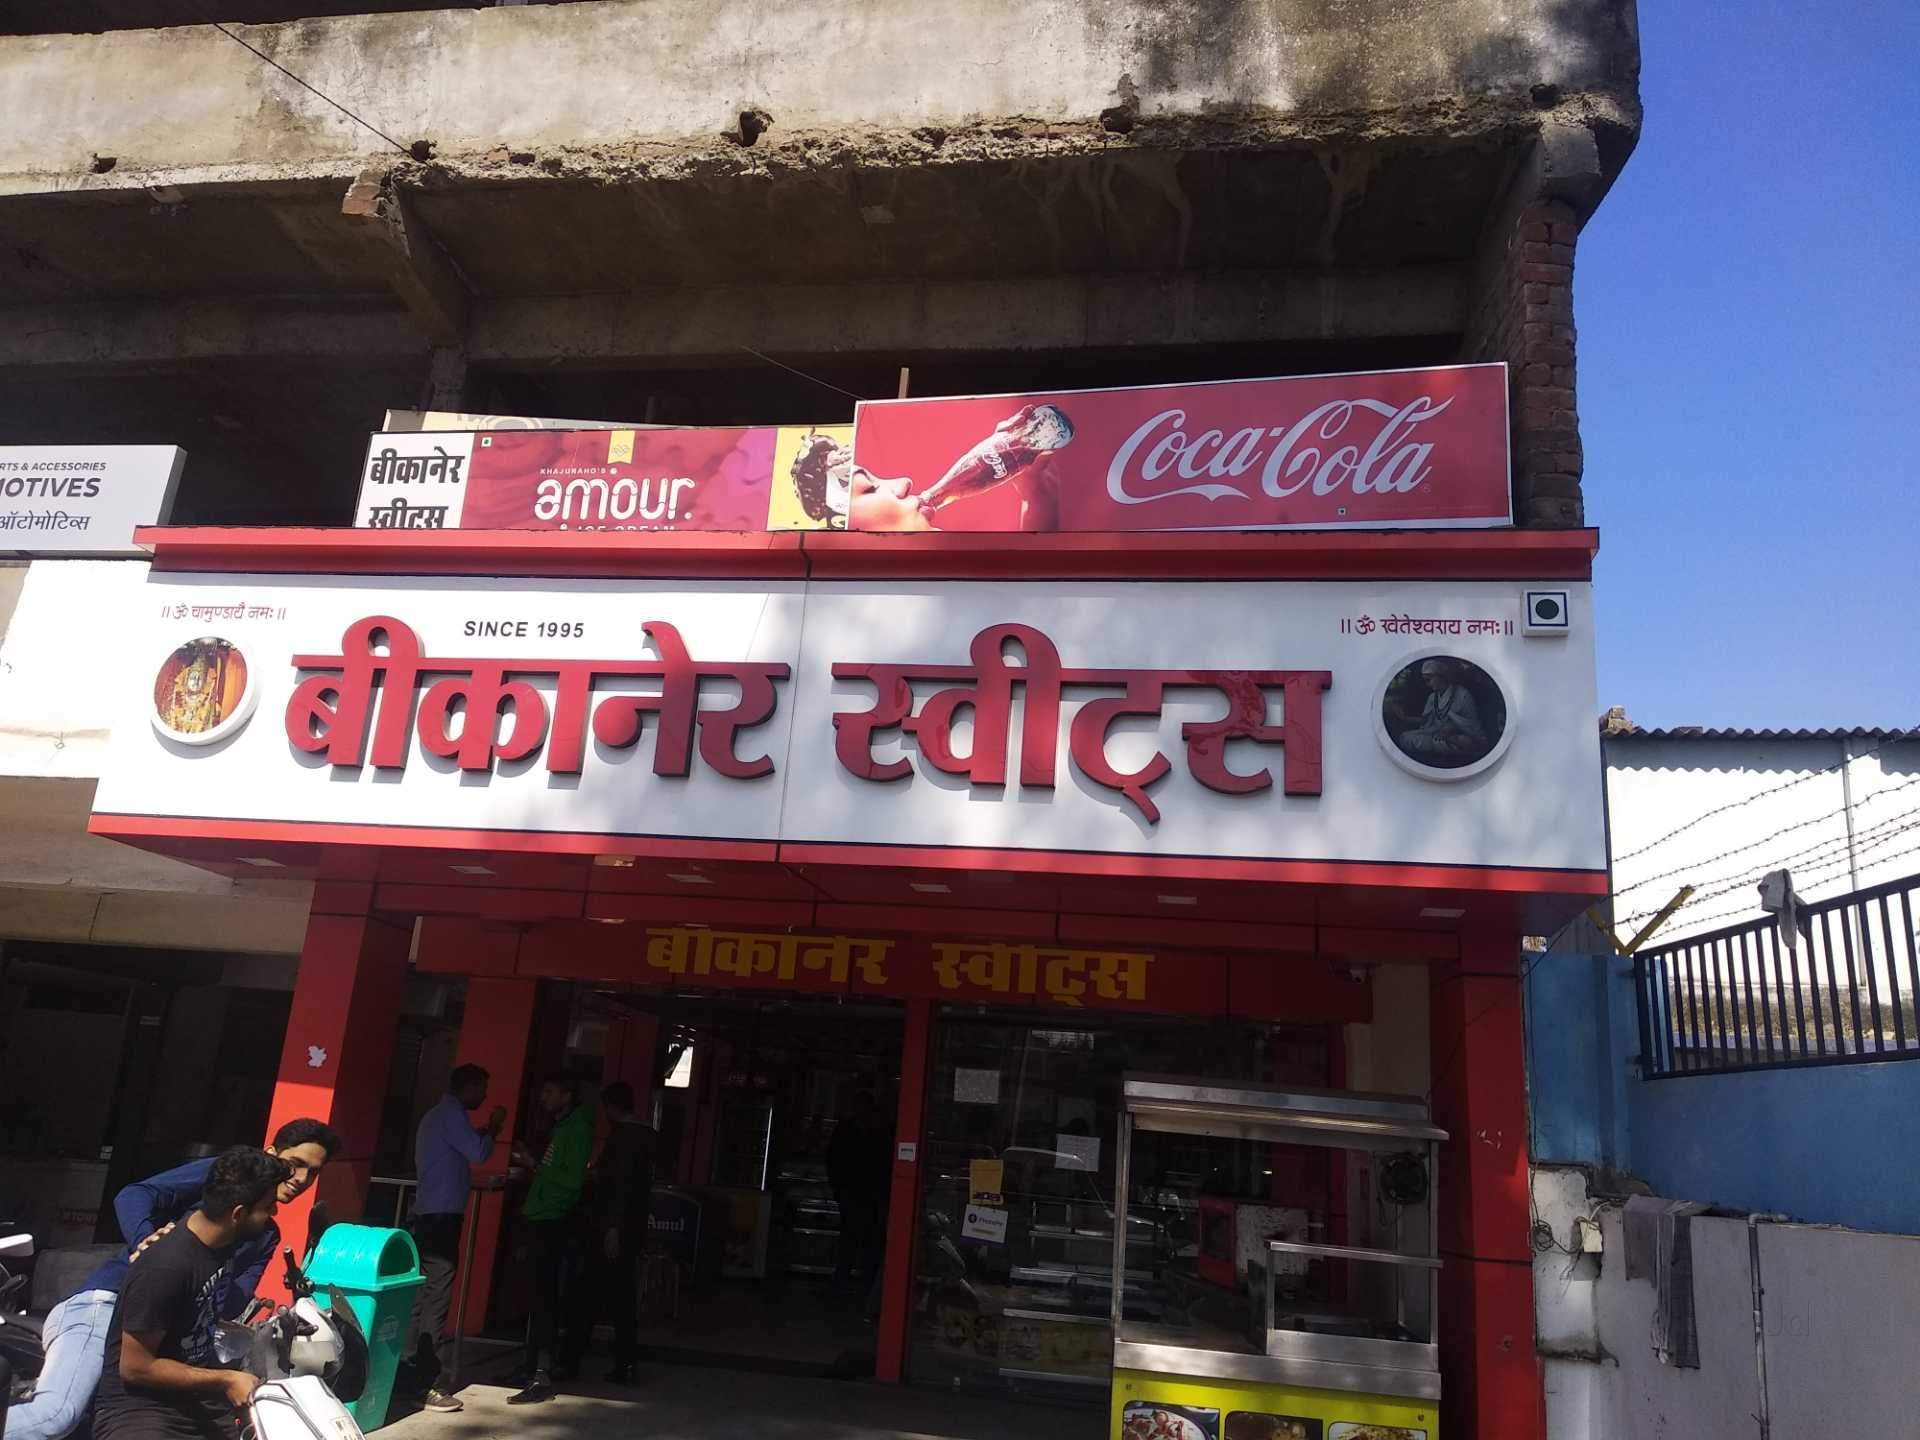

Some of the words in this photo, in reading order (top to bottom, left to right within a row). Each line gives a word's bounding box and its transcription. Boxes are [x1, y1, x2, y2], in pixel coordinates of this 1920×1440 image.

[1107, 394, 1455, 504] Coca-Cola
[21, 463, 29, 471] &
[31, 462, 107, 471] ACCESSORIES
[370, 446, 465, 484] बीकानेर
[0, 477, 101, 497] OTIVES
[464, 620, 528, 637] SINCE
[536, 622, 585, 638] 1995
[285, 615, 791, 779] बीकानेर
[831, 622, 1332, 825] स्वीट्स
